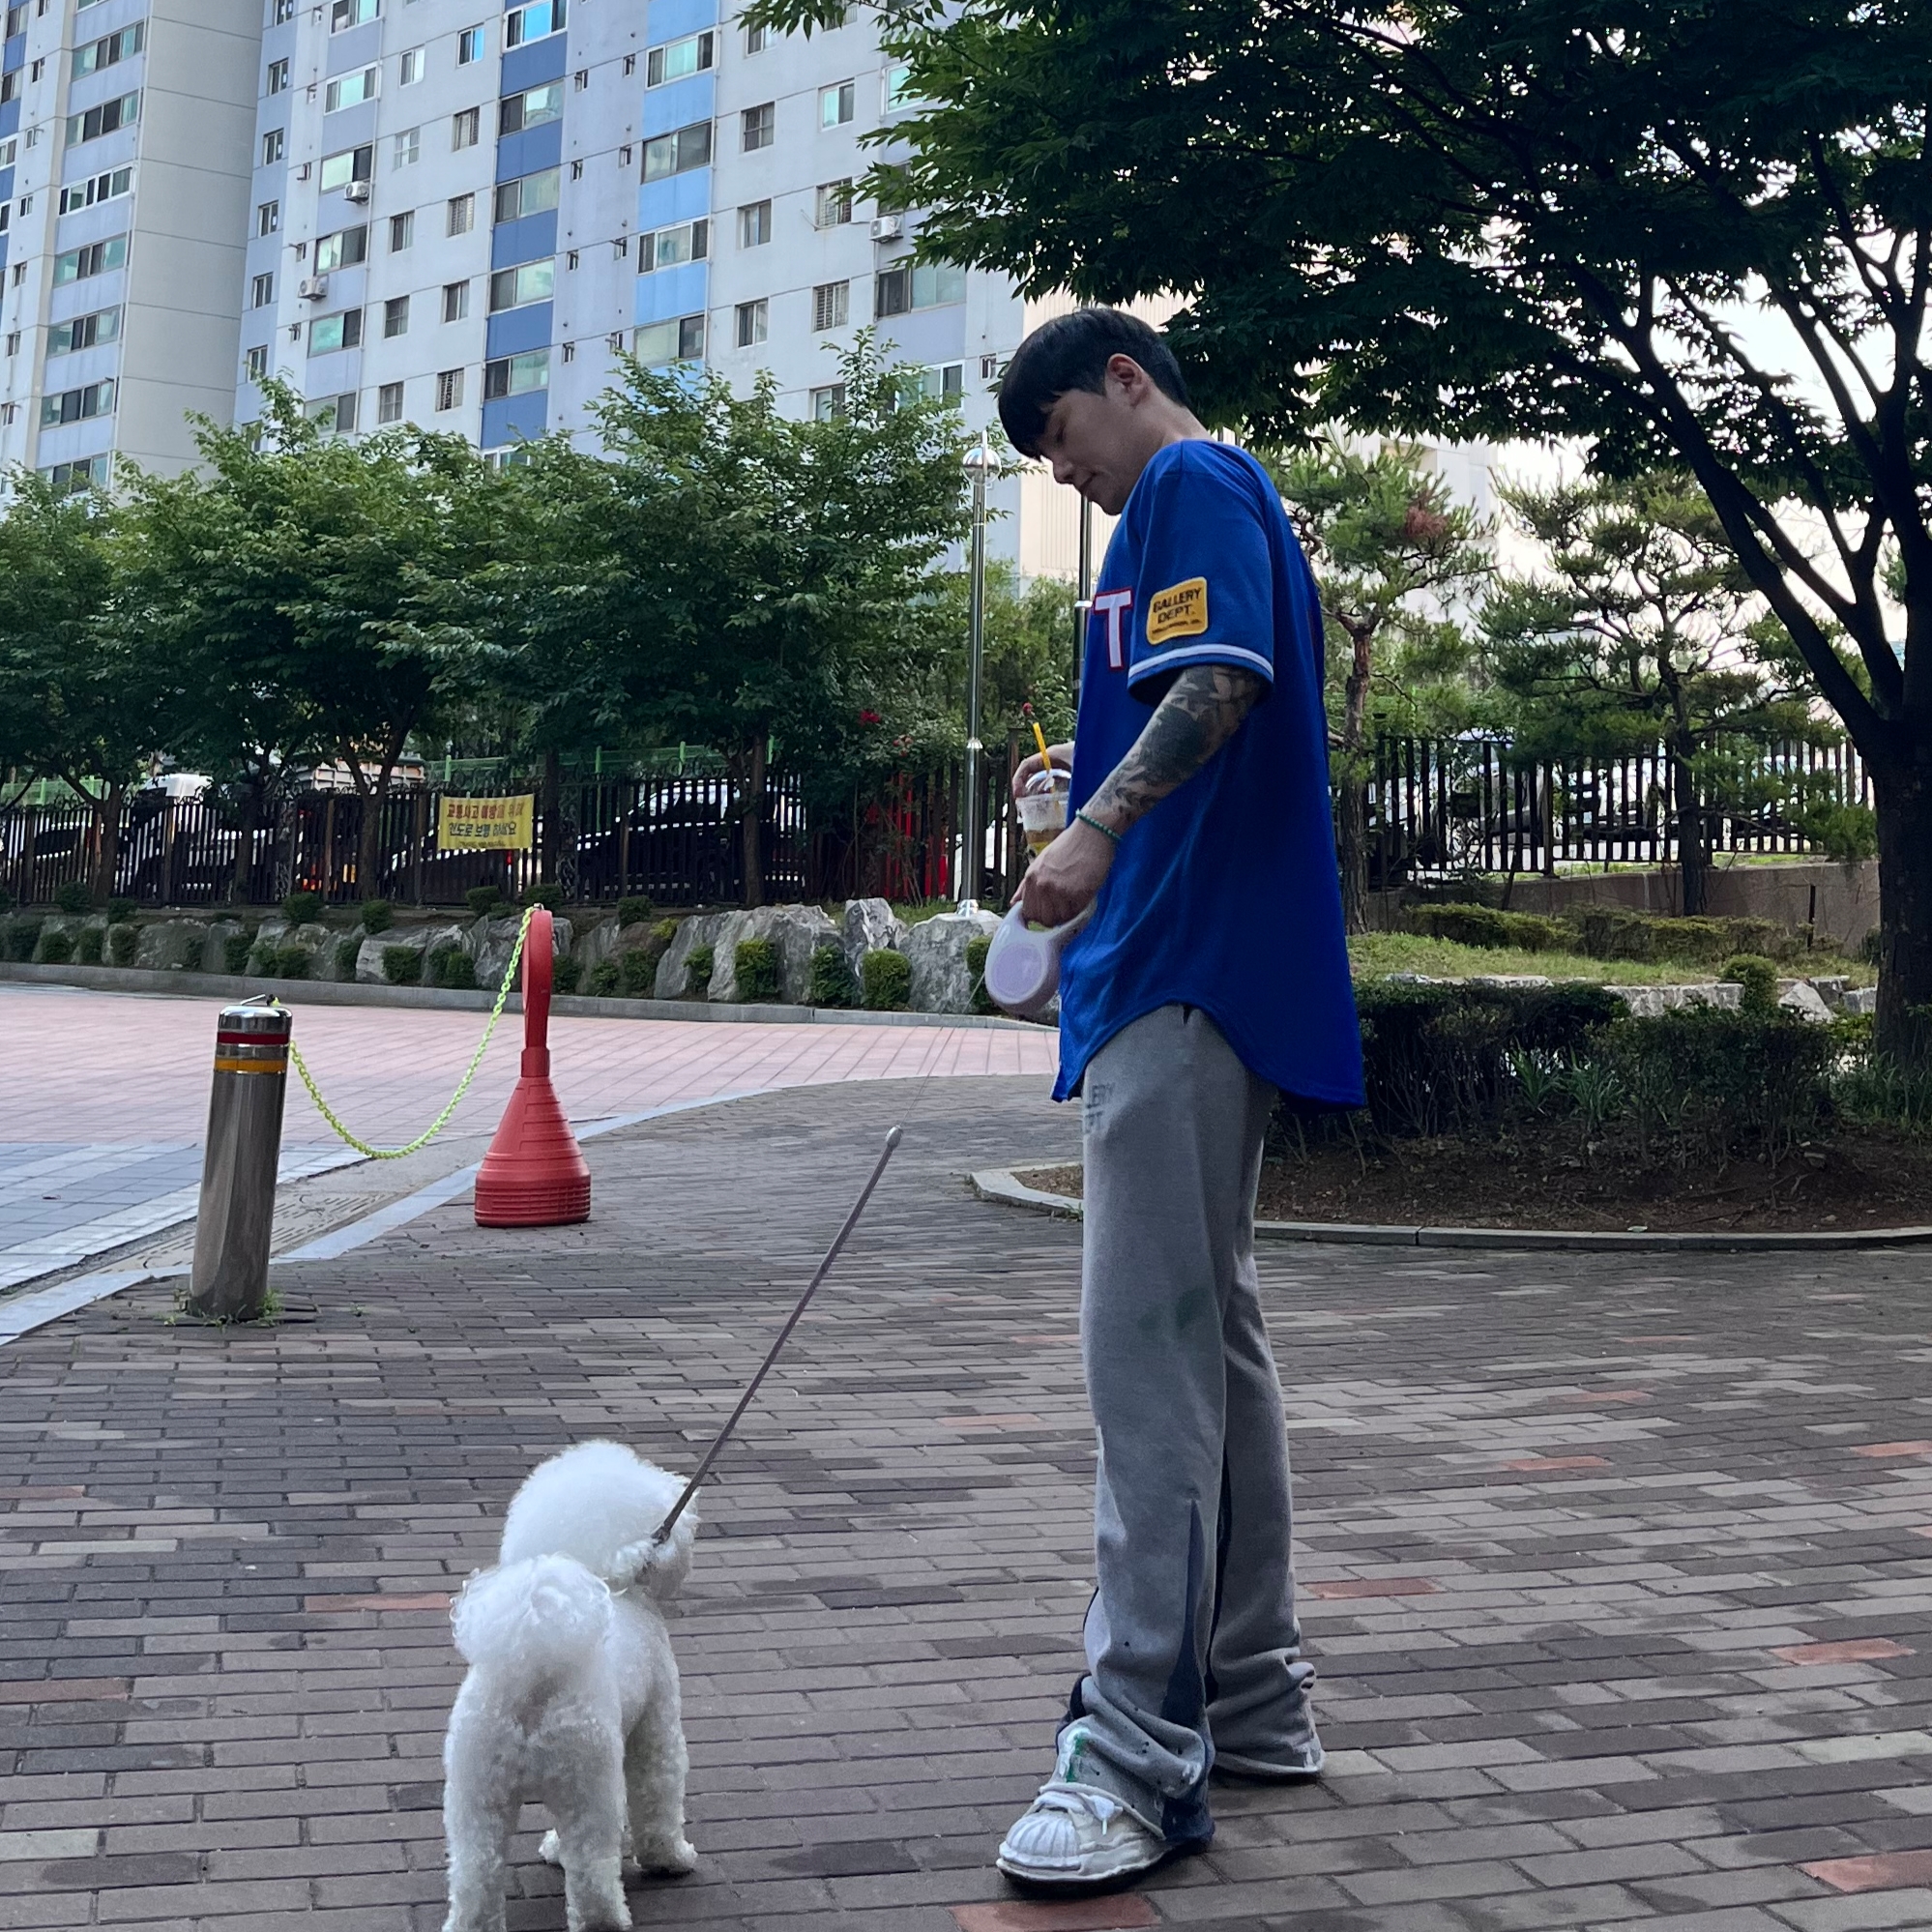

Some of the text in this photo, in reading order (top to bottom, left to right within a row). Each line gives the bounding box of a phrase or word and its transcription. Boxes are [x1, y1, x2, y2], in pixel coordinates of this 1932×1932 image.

[1153, 587, 1202, 613] GALLERY
[1094, 587, 1132, 670] T
[447, 805, 480, 819] 교통사고
[481, 805, 506, 820] 예방을
[449, 822, 474, 837] 인도로
